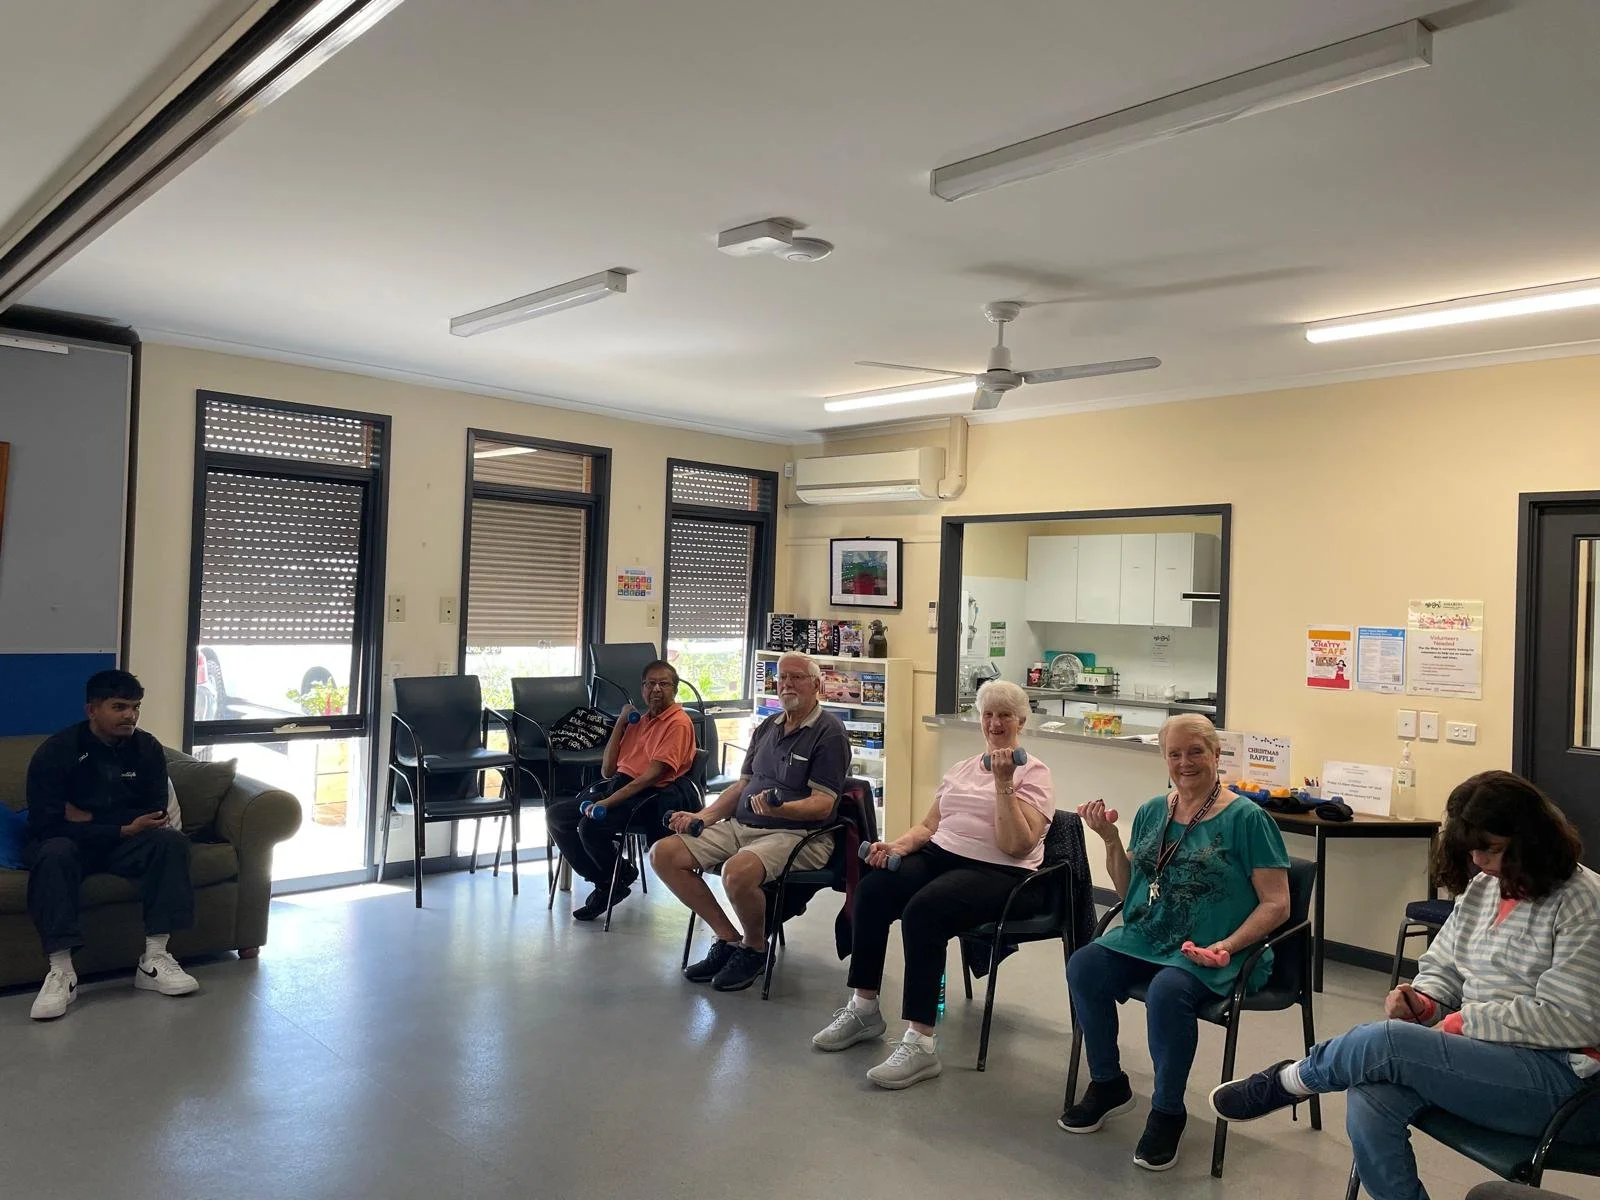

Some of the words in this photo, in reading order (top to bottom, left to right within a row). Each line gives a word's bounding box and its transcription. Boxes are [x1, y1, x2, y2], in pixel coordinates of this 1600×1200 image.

[772, 618, 782, 641] 1000
[784, 619, 794, 642] 1000
[1314, 640, 1341, 648] CHATTY
[755, 661, 765, 682] 1000
[1248, 748, 1279, 756] CHRISTMAS
[1249, 754, 1275, 762] RAFFLE
